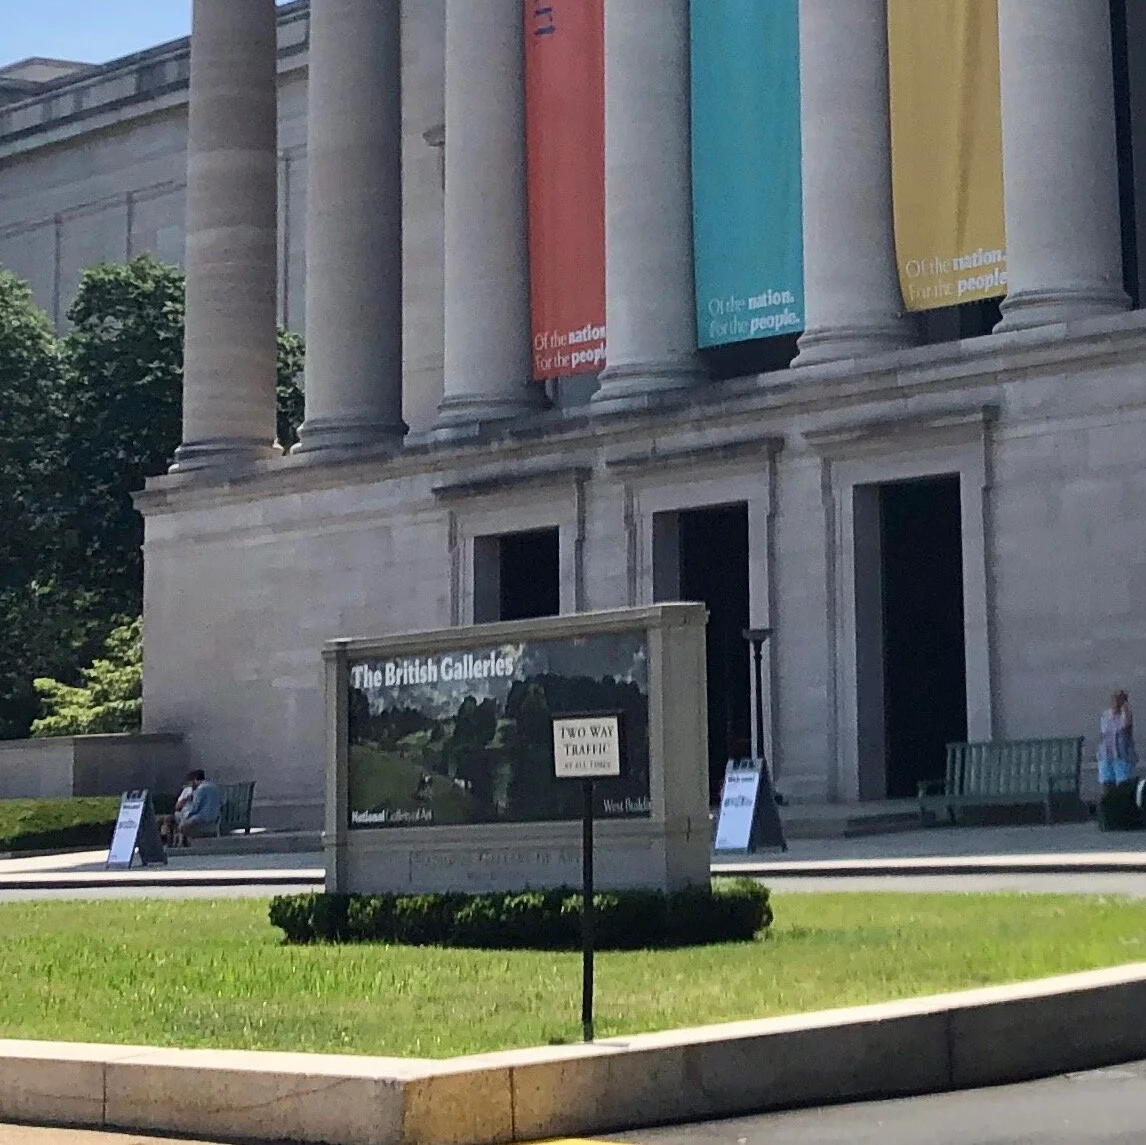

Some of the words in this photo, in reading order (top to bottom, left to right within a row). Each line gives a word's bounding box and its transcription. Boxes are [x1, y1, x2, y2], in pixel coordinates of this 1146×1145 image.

[930, 256, 950, 275] the
[747, 288, 795, 310] nation.
[750, 307, 800, 335] people.
[549, 329, 568, 348] the
[351, 663, 382, 689] The
[384, 656, 439, 687] British
[440, 650, 515, 682] Galleries
[560, 726, 586, 739] TWO
[589, 724, 614, 738] WAY
[563, 742, 611, 756] TRAFFIC
[351, 809, 386, 823] National
